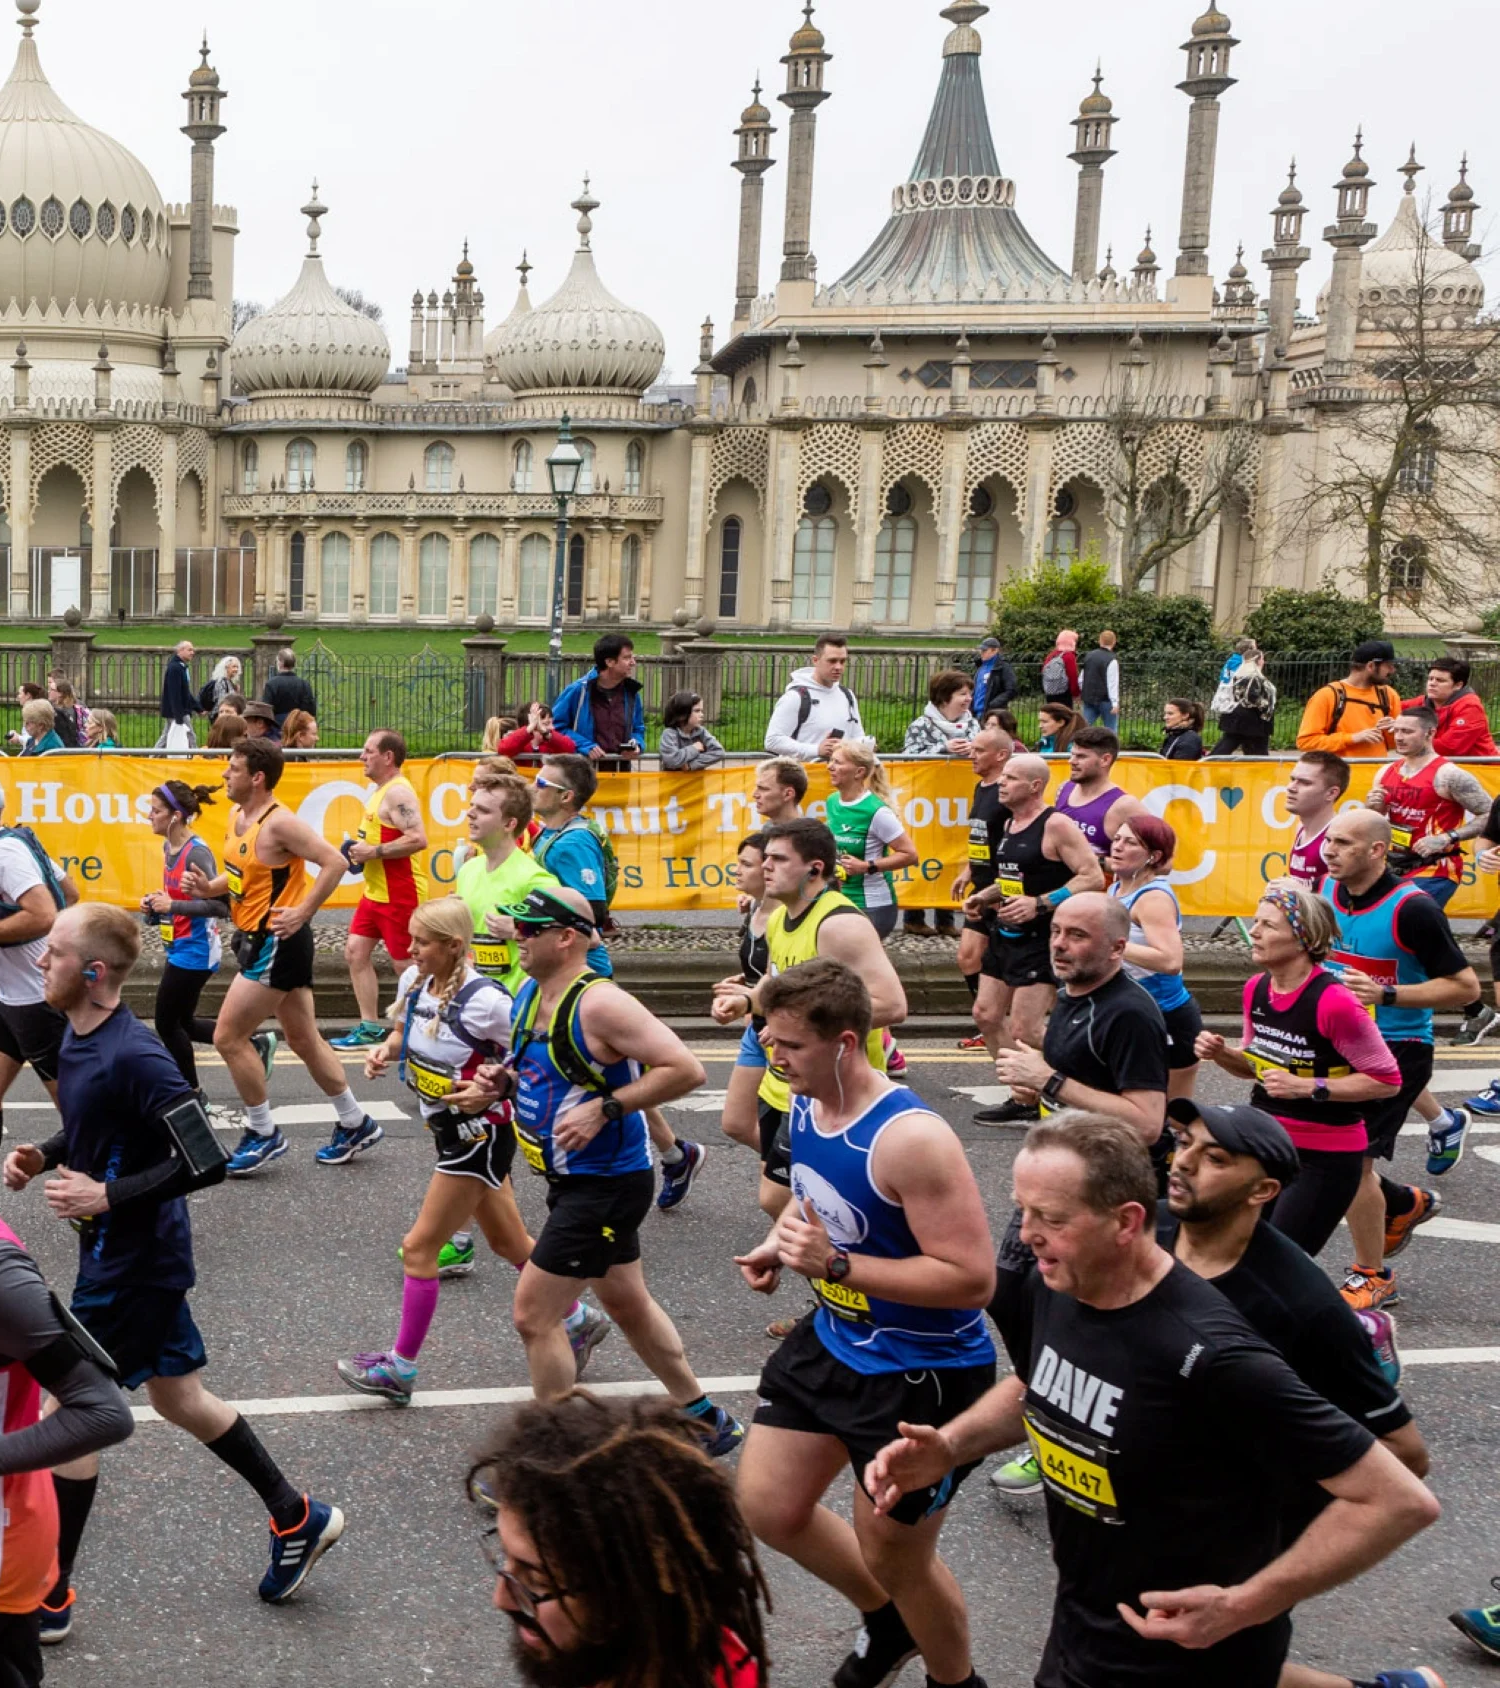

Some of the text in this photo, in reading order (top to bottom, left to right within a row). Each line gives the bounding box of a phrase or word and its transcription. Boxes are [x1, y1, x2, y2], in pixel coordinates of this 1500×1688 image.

[15, 781, 152, 825] Hous
[707, 792, 827, 832] Tre
[59, 855, 103, 880] re
[1179, 1343, 1205, 1378] Reebok
[1030, 1344, 1124, 1438] DAVE
[1046, 1453, 1102, 1496] 44147
